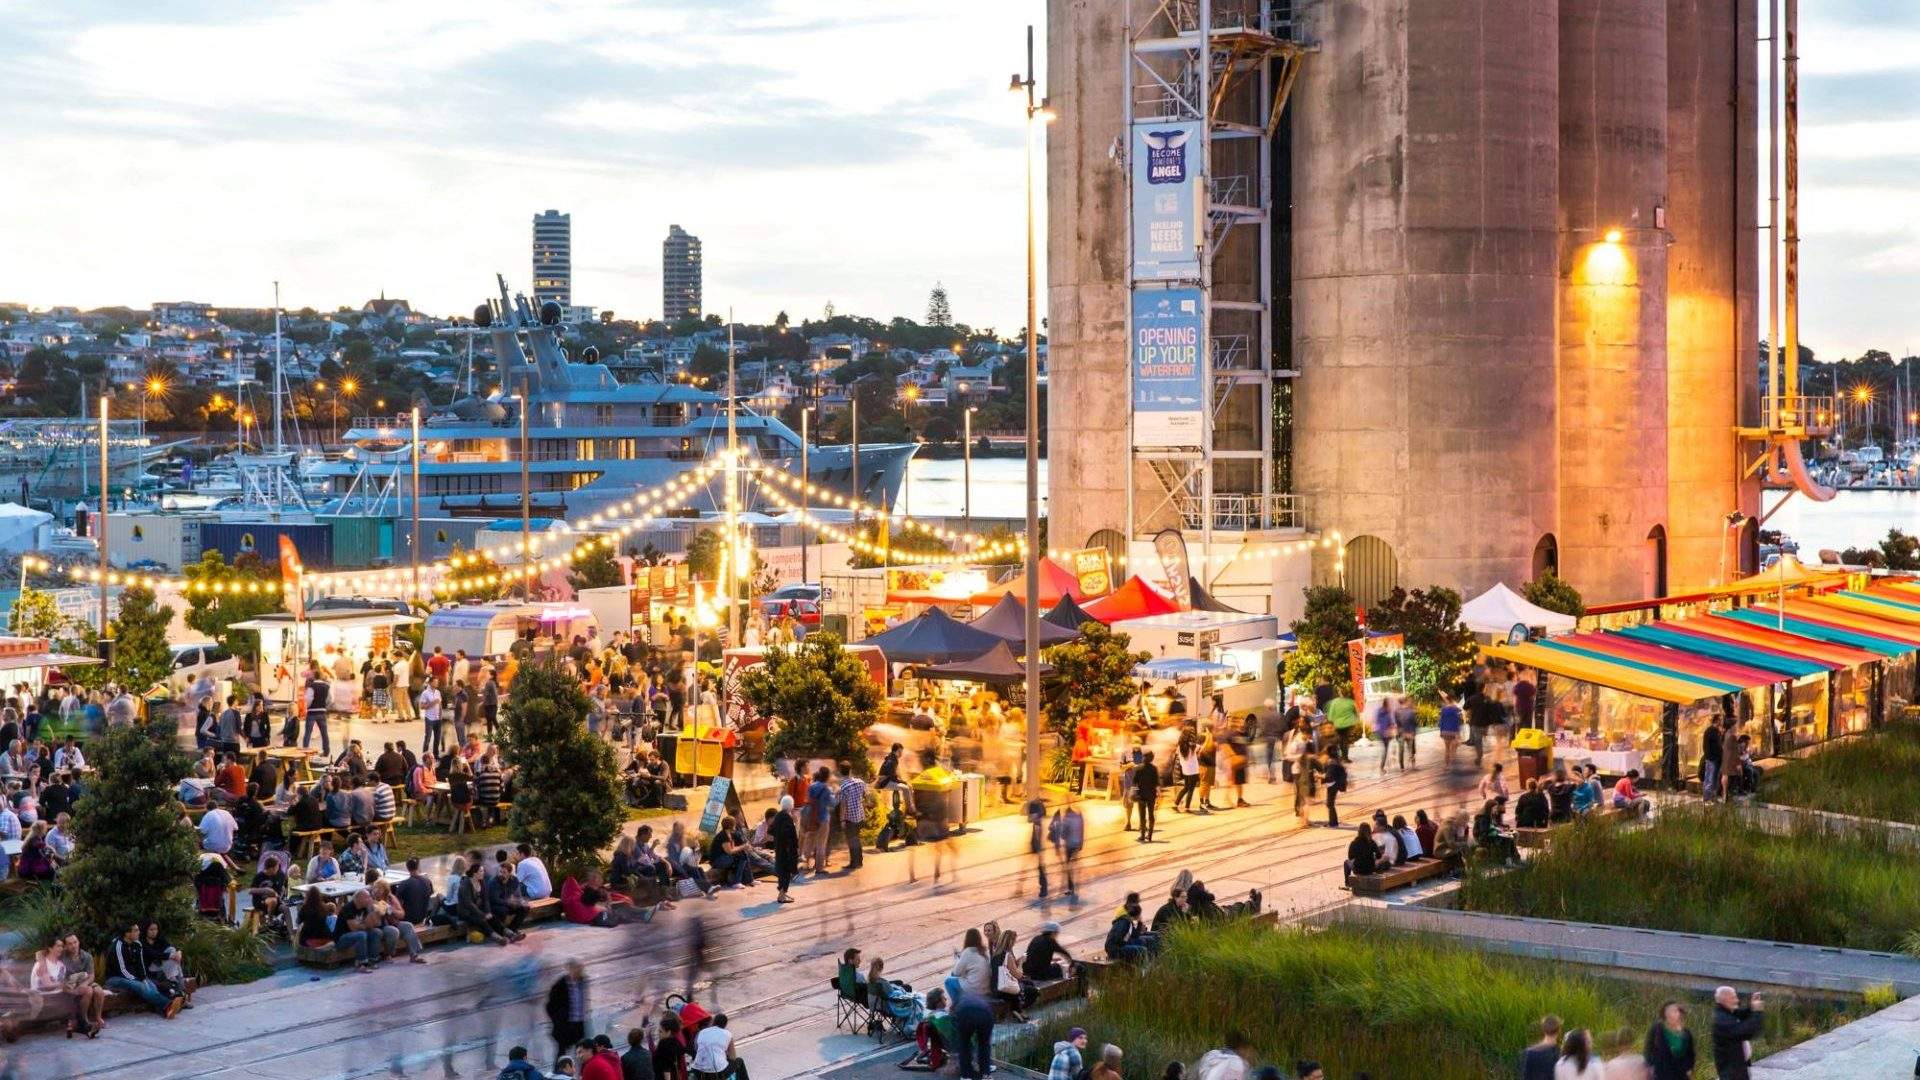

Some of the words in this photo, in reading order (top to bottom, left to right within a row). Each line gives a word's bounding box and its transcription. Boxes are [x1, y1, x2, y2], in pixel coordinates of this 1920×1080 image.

[1152, 149, 1181, 158] BECOME
[1152, 165, 1182, 177] ANGEL
[1150, 229, 1183, 241] NEEDS
[1150, 241, 1183, 253] ANGELS
[1139, 327, 1196, 346] OPENING
[1139, 346, 1157, 364] UP
[1160, 345, 1196, 364] YOUR
[1139, 364, 1196, 377] WATERFRONT
